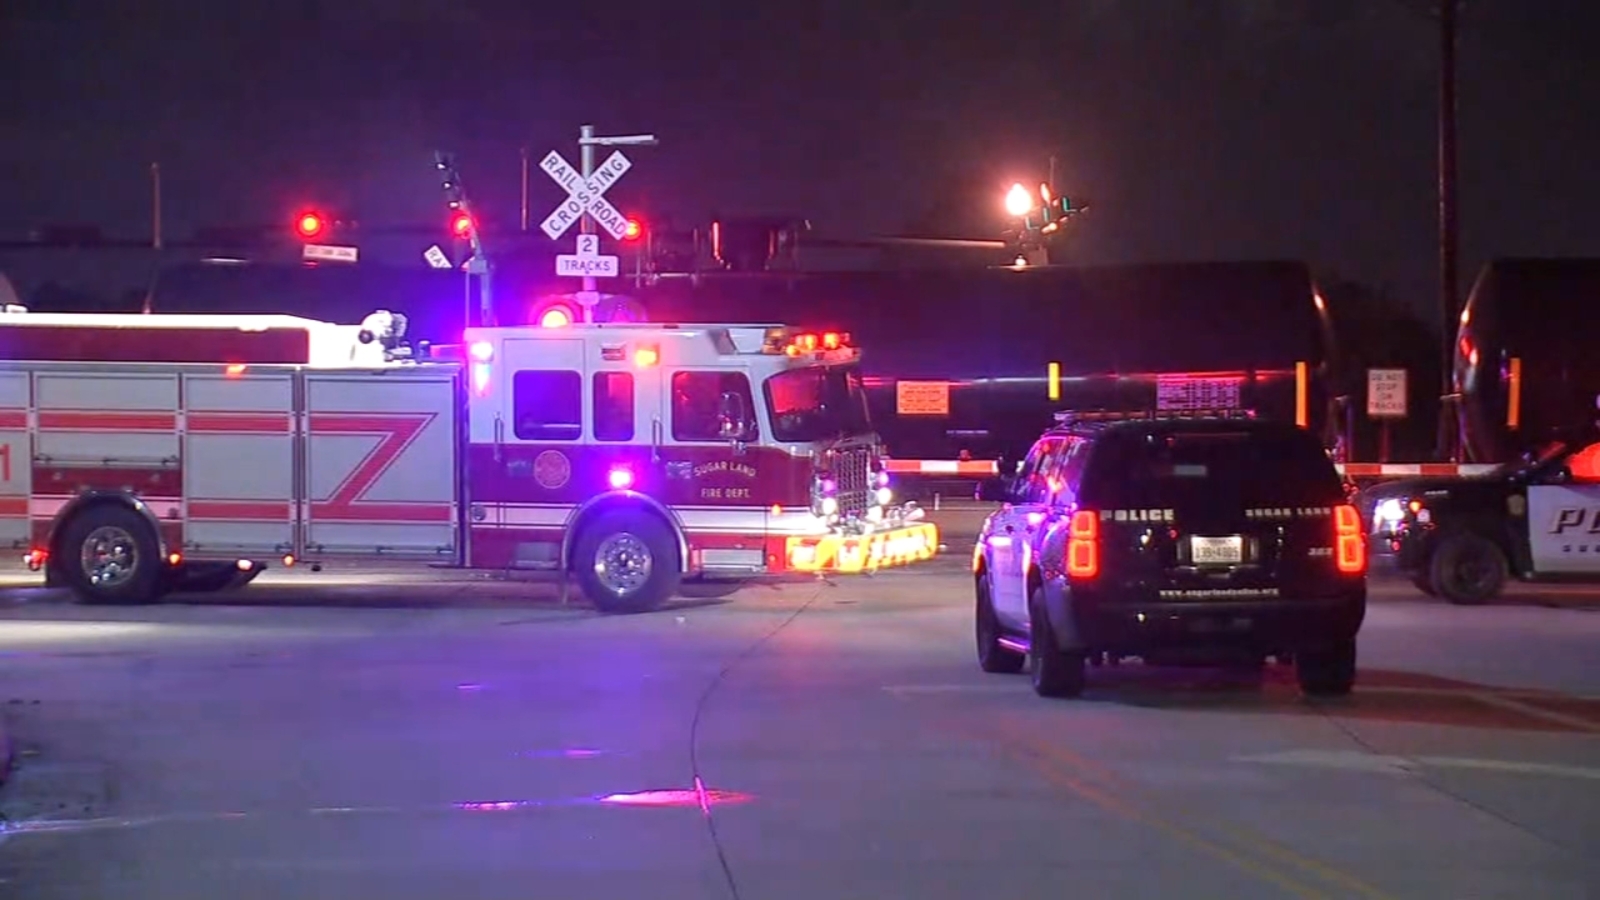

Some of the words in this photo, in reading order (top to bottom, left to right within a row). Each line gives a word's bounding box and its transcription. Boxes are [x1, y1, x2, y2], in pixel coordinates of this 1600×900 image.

[545, 156, 577, 190] RAIL
[591, 200, 627, 235] ROAD
[549, 158, 624, 232] CROSSING
[582, 239, 593, 252] 2
[563, 259, 611, 271] TRACKS
[694, 461, 728, 477] SUGAR
[730, 461, 756, 477] LAND
[701, 488, 722, 498] FIRE
[1100, 508, 1174, 521] POLICE
